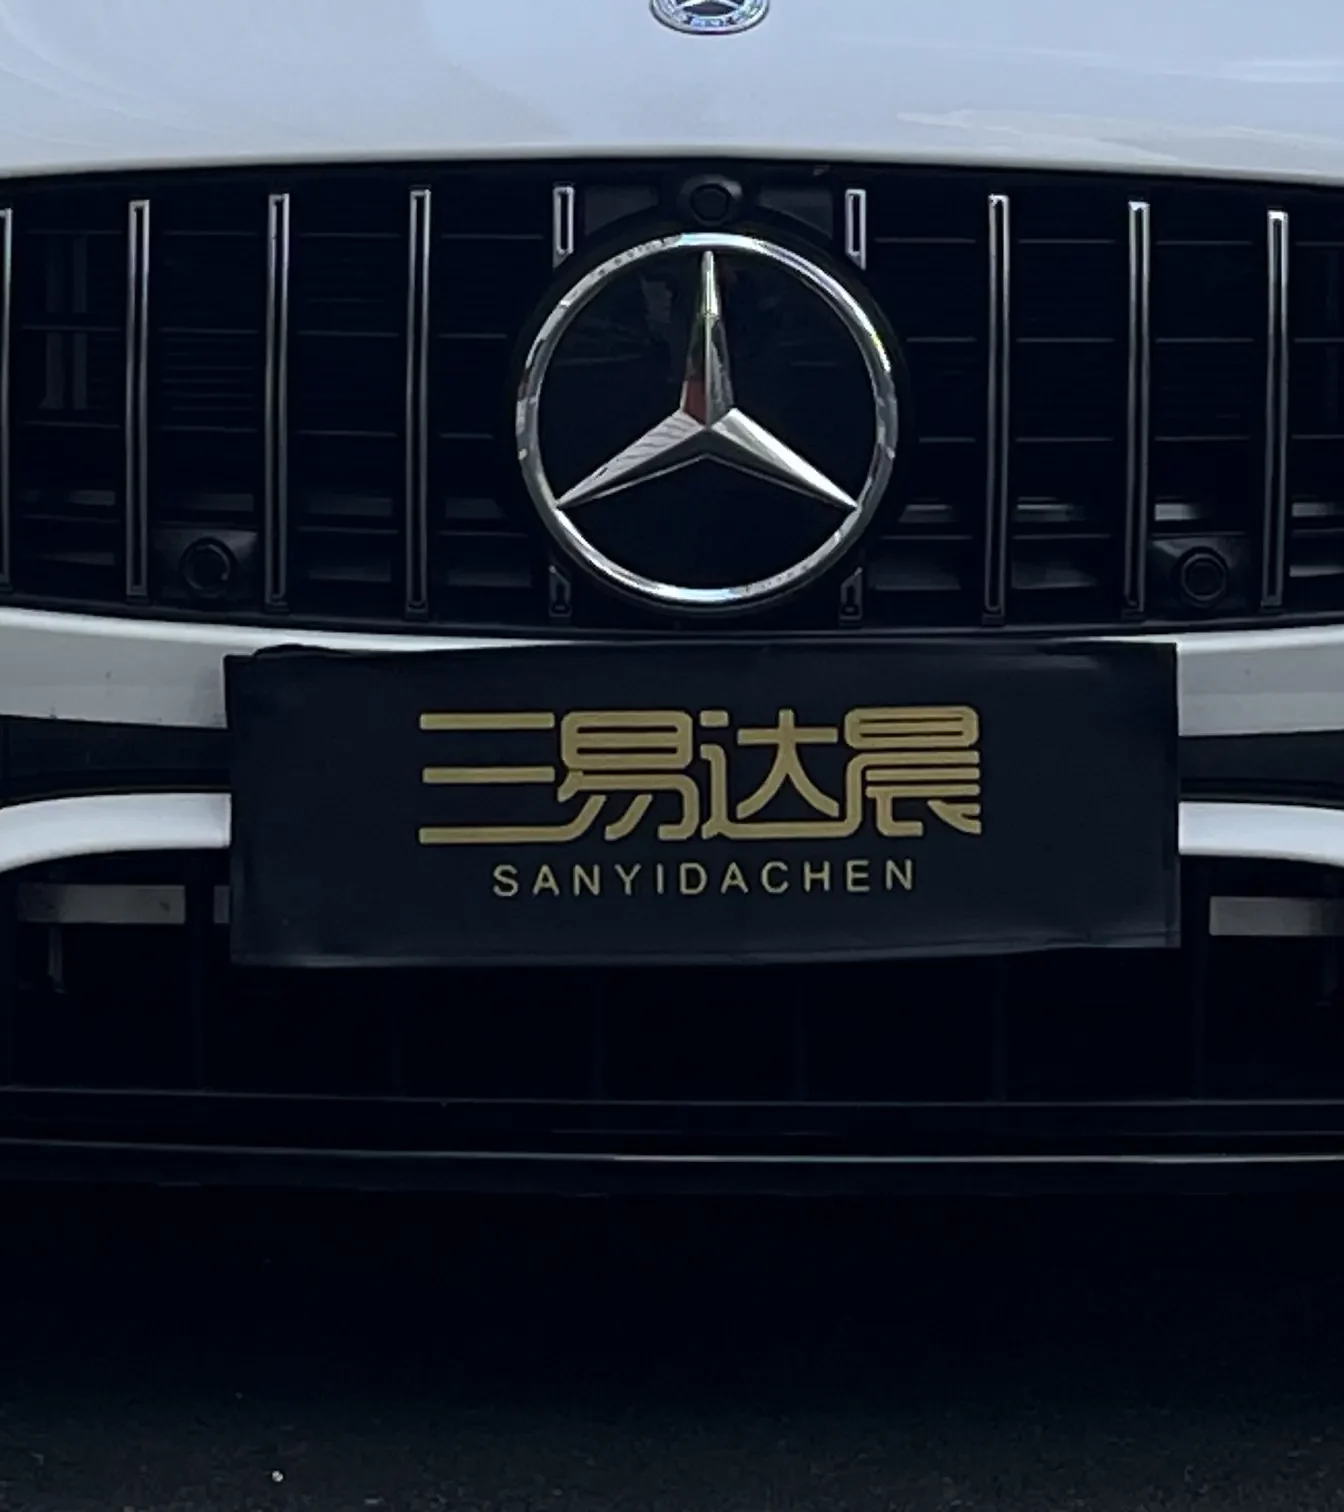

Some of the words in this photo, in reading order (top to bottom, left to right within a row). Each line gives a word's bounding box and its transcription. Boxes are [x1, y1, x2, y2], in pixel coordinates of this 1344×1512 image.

[419, 705, 982, 845] 三易达晨
[492, 859, 915, 897] SANYIDACHEN
